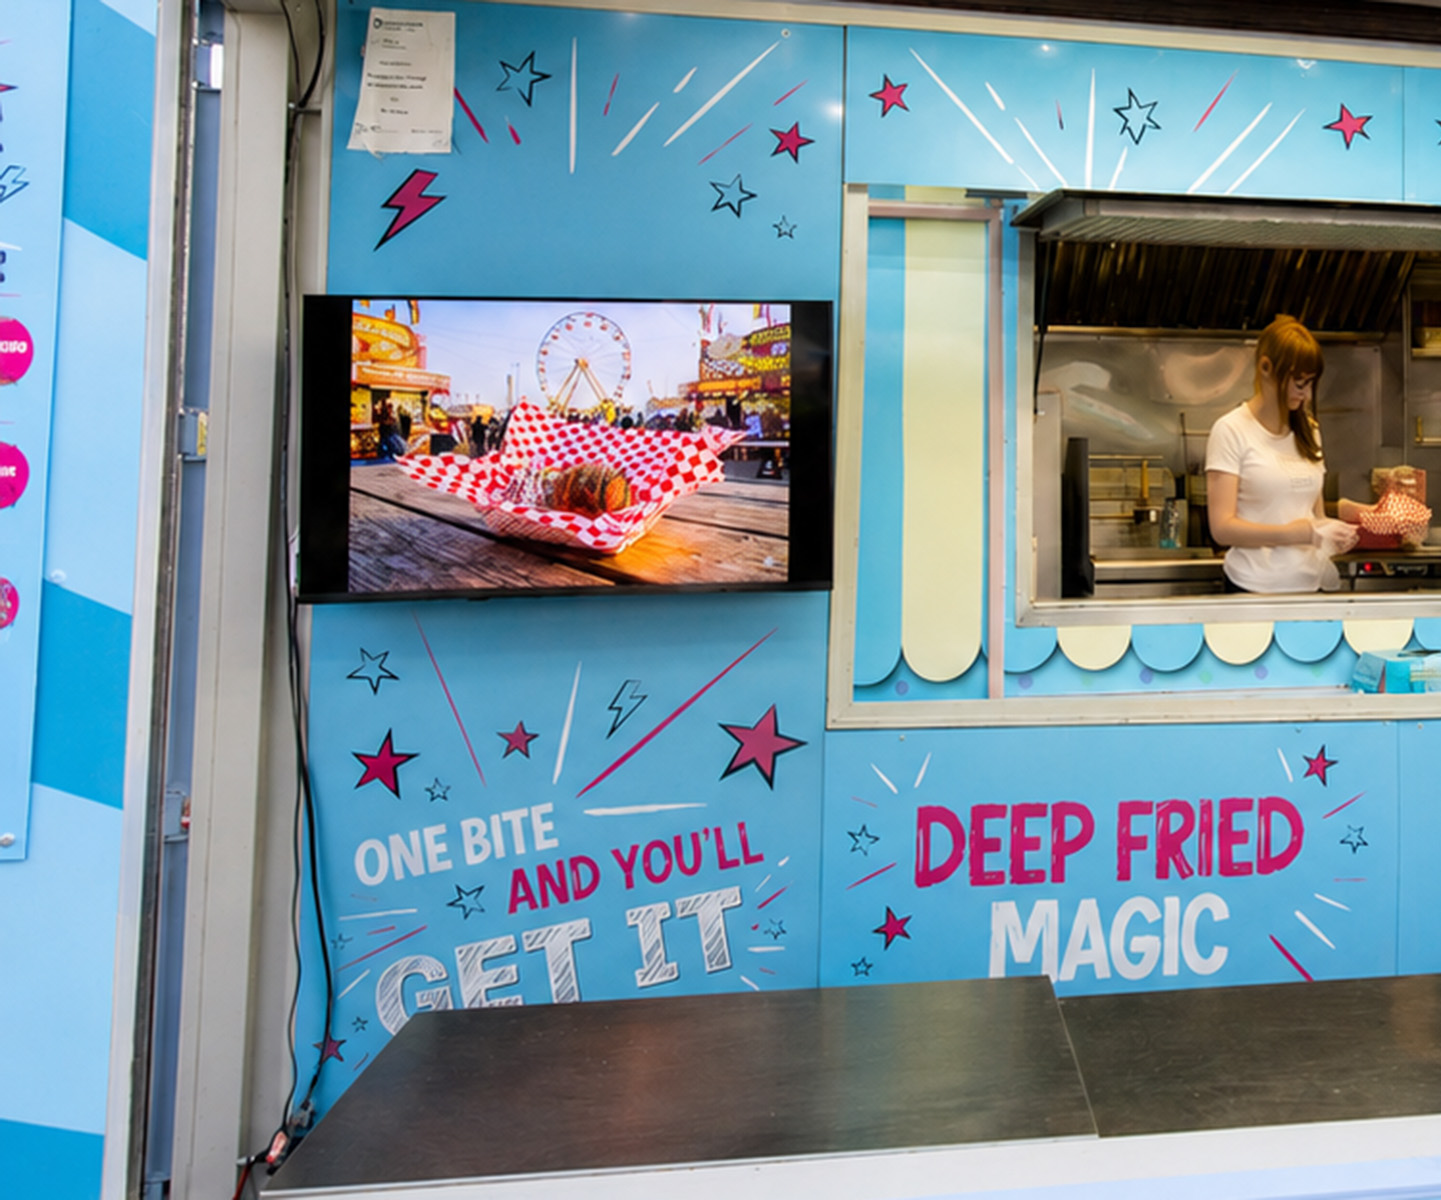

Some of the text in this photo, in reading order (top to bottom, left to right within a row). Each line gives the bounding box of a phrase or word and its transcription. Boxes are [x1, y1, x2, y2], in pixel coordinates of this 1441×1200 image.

[354, 802, 559, 887] ONE BITE
[507, 822, 764, 915] AND YOU'LL
[914, 796, 1305, 888] DEEP FRIED
[375, 886, 743, 1037] GET IT
[988, 892, 1231, 982] MAGIC
